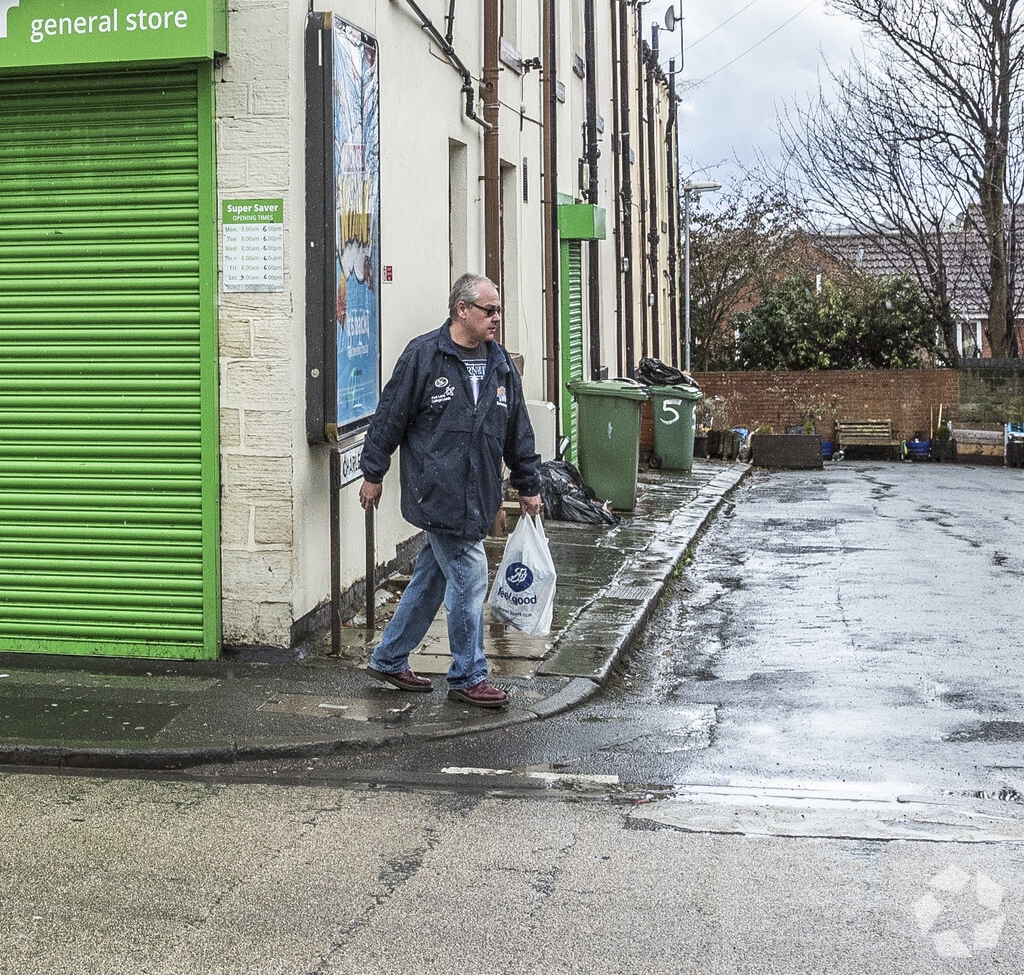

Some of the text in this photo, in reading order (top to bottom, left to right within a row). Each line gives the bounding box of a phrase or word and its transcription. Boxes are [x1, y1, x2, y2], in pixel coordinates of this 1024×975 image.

[30, 9, 118, 43] general
[125, 9, 188, 31] store
[227, 205, 252, 213] Super
[660, 399, 682, 425] 5
[343, 452, 362, 477] CHARLE
[497, 587, 537, 605] feel good
